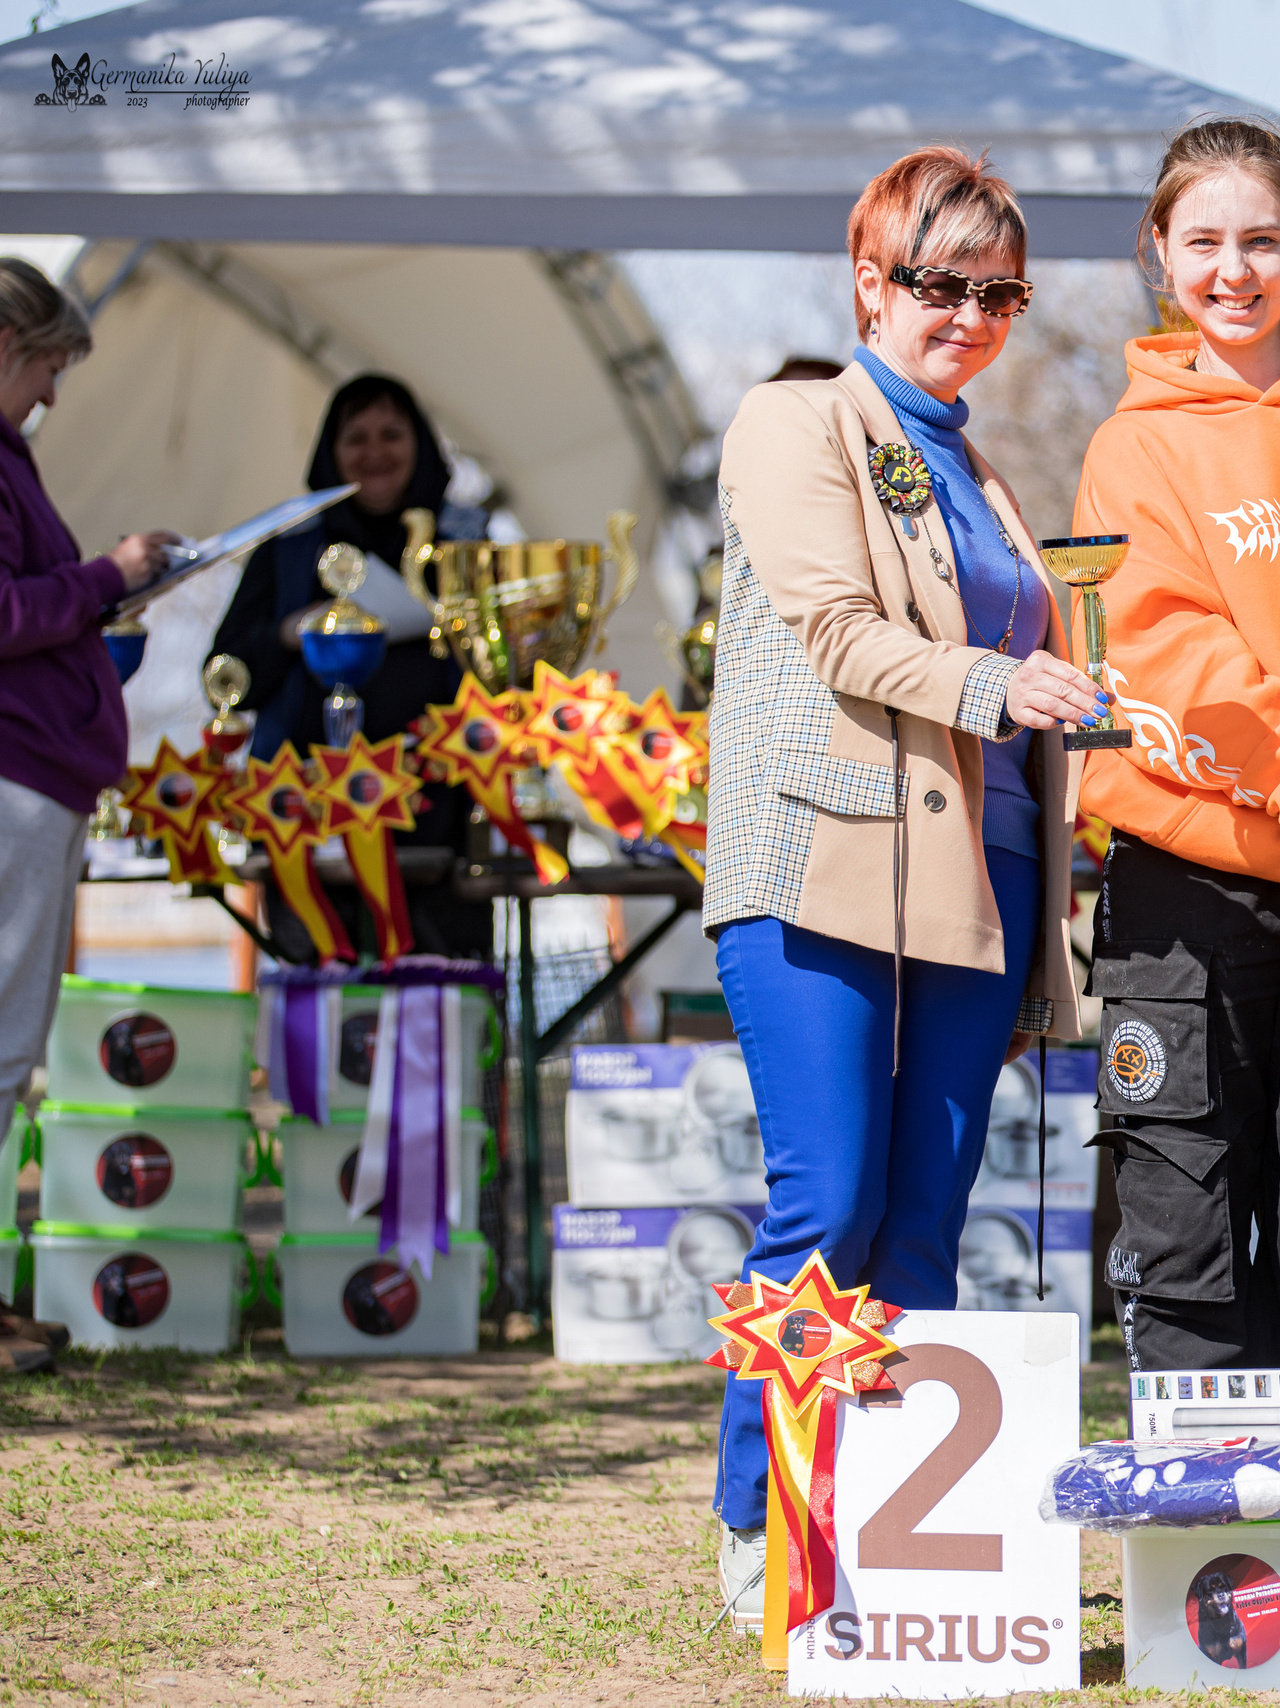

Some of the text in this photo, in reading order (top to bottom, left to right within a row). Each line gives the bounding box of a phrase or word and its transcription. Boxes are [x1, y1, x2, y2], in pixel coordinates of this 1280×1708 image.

[1148, 1412, 1158, 1437] 750ML
[857, 1343, 1003, 1572] 2
[806, 1617, 816, 1660] REMIUM
